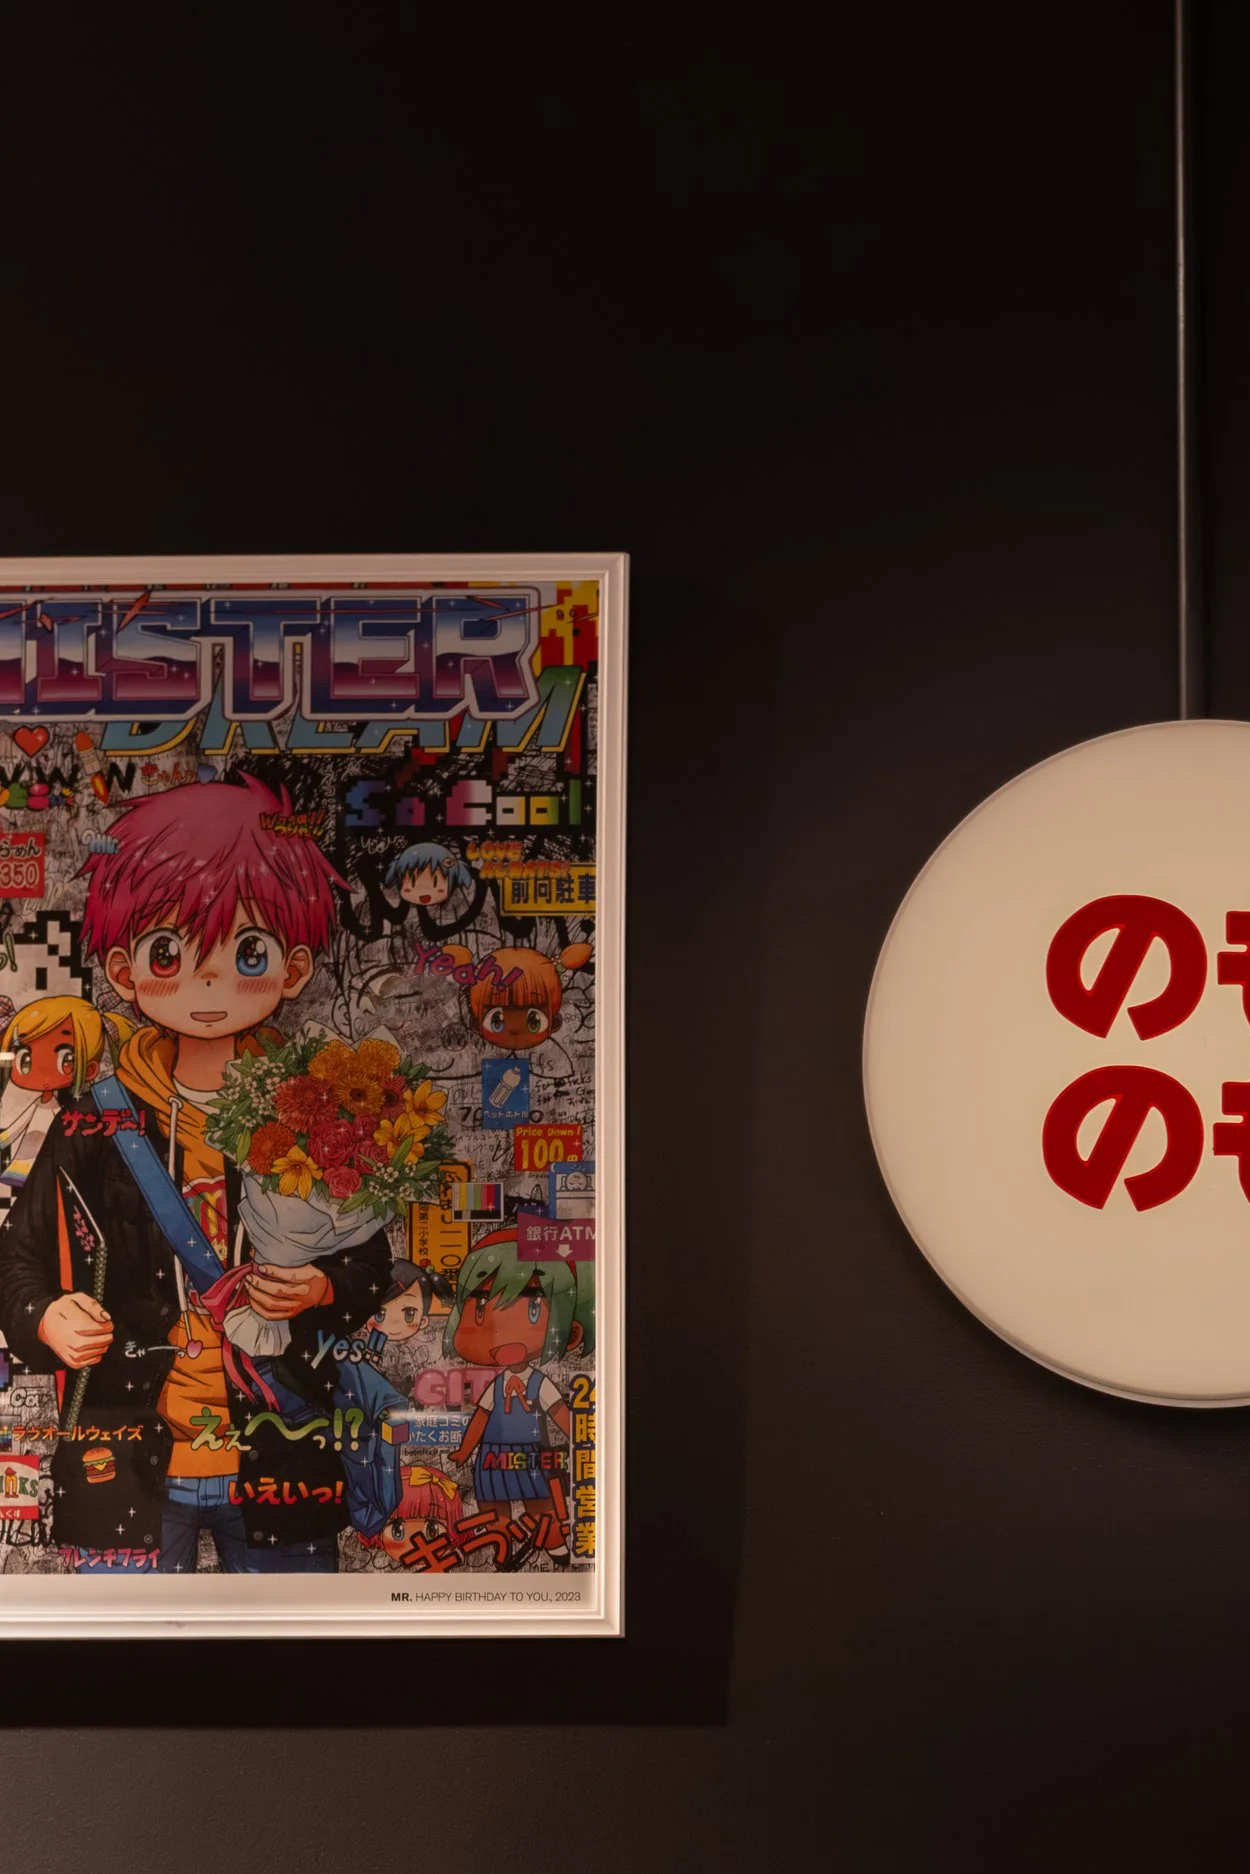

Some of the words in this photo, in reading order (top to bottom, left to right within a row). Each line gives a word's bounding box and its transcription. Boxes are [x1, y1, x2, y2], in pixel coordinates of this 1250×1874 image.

[0, 593, 541, 722] ISTER
[445, 779, 582, 826] Cool
[414, 941, 524, 992] Yeah!
[516, 1127, 543, 1137] Price
[526, 1225, 596, 1241] 銀行ATM
[482, 1450, 569, 1471] MISTER
[58, 1547, 161, 1569] フレンチフライ
[390, 1592, 413, 1602] MR.
[416, 1592, 452, 1602] HAPPY
[454, 1592, 507, 1602] BIRTHDAY
[509, 1592, 524, 1602] TO
[526, 1592, 554, 1603] YOU,
[555, 1592, 582, 1602] 2023
